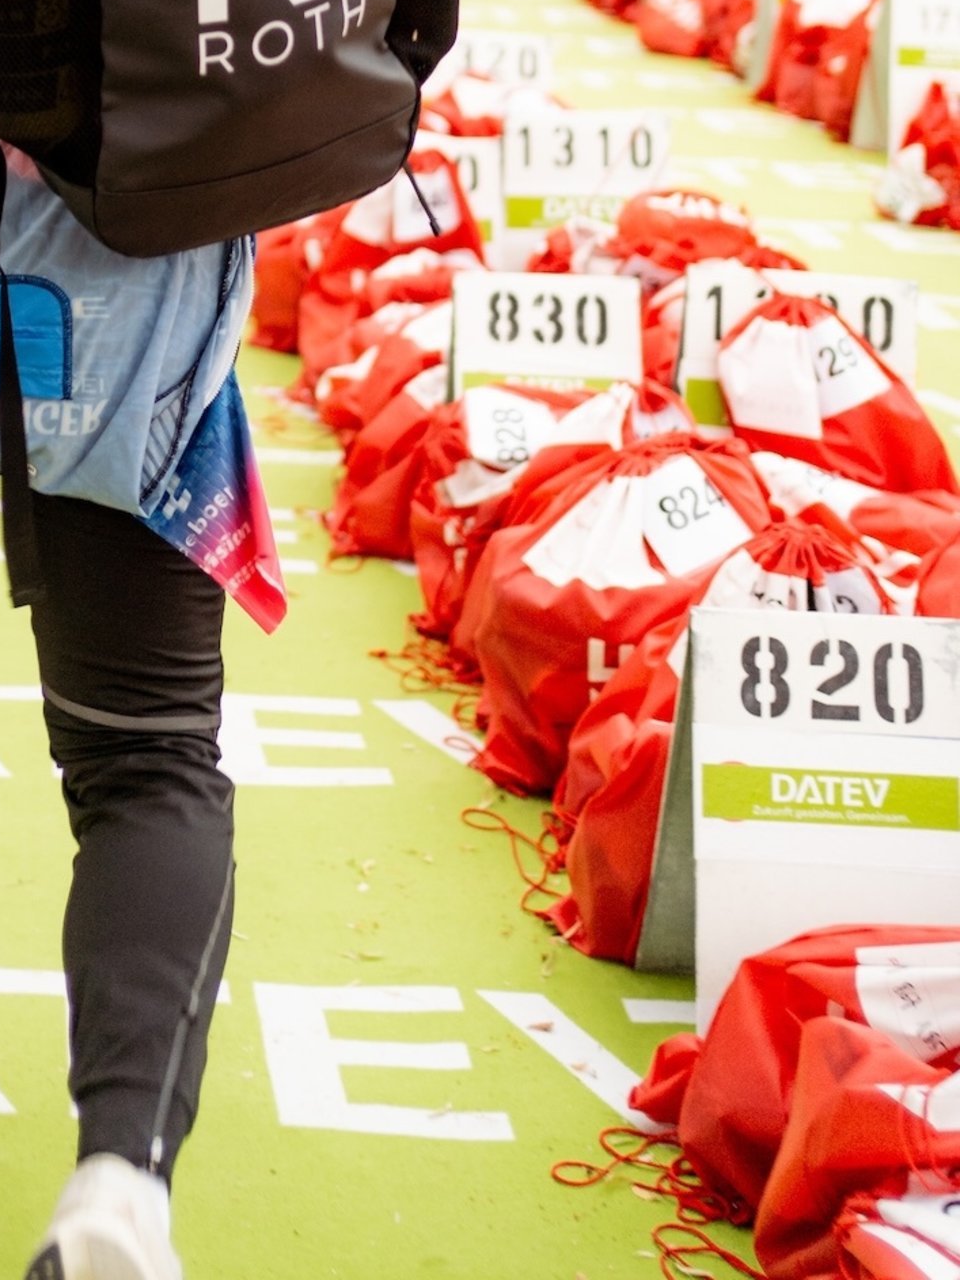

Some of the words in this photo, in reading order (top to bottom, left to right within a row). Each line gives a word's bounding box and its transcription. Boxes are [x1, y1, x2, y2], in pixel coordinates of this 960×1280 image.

[519, 125, 653, 169] 1310
[488, 291, 609, 347] 830
[740, 635, 925, 724] 820
[770, 772, 890, 809] DATEV
